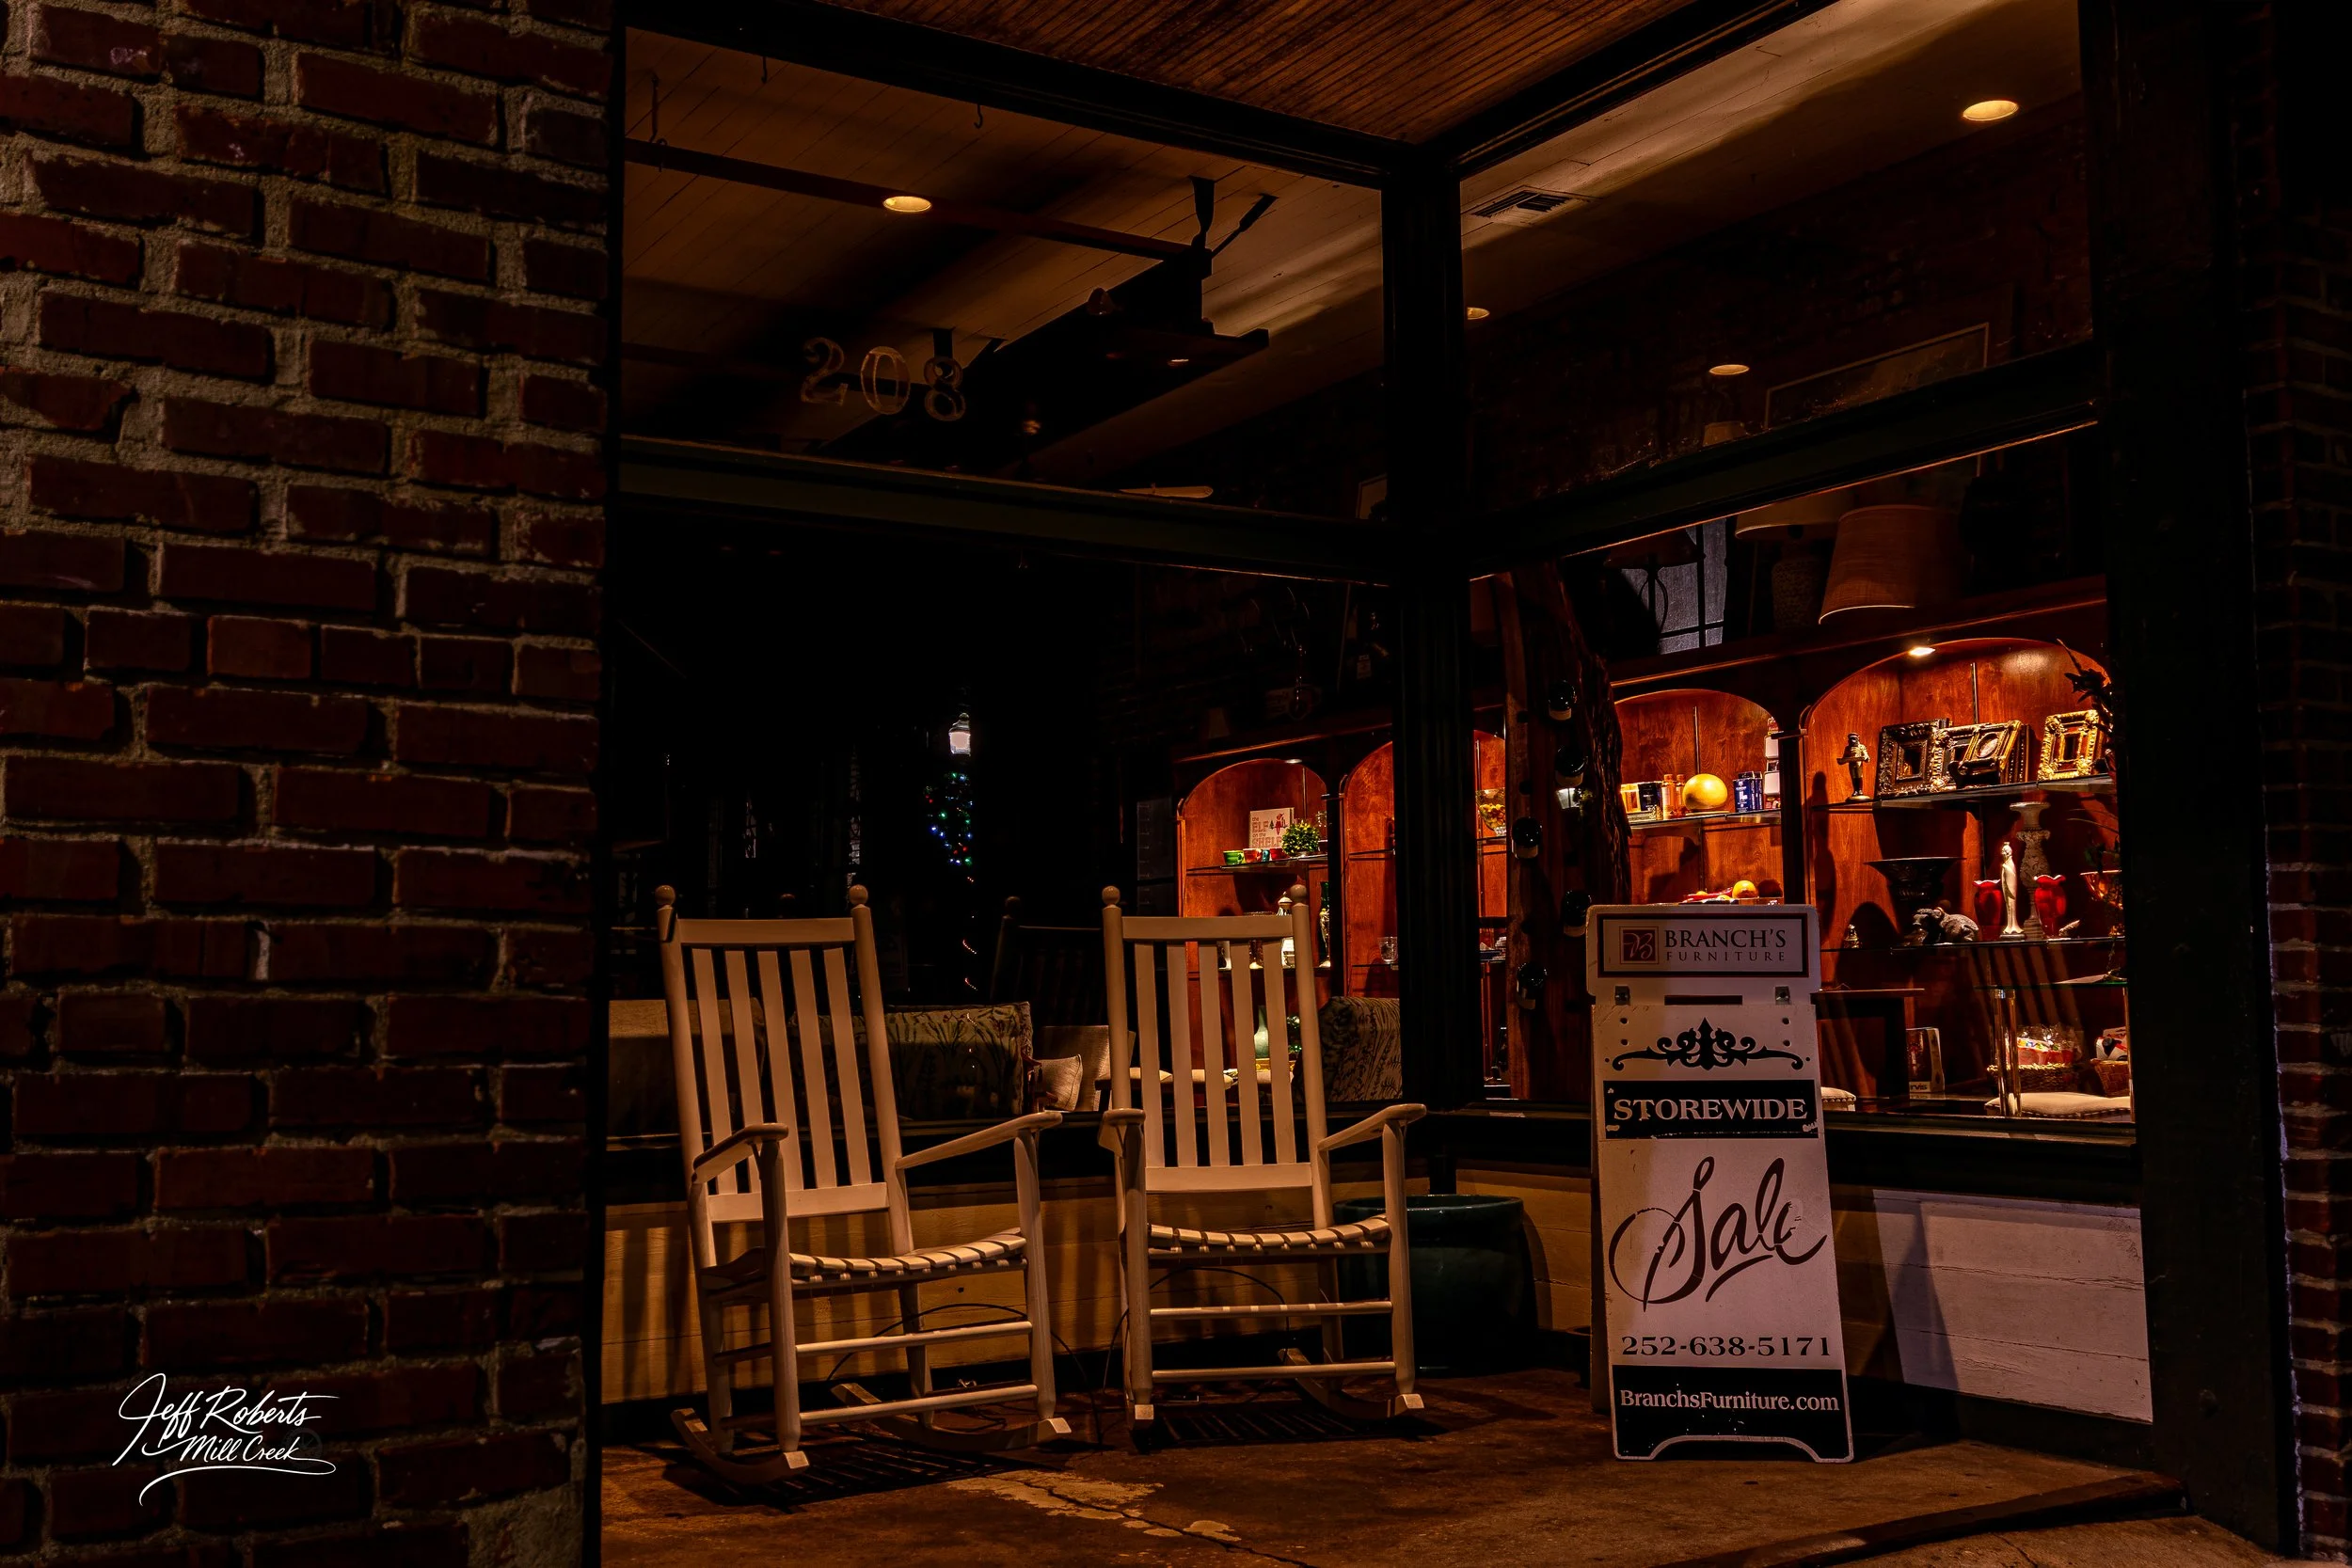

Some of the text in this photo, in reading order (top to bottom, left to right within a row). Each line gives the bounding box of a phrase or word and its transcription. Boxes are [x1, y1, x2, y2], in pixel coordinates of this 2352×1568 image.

[800, 335, 968, 422] 208
[1252, 821, 1268, 832] ELF
[1664, 929, 1786, 948] BRANCH'S
[1666, 951, 1786, 961] FURNITURE
[1613, 1099, 1808, 1121] STOREWIDE
[1609, 1156, 1828, 1312] Sale
[1621, 1336, 1831, 1356] 252-638-5171
[1620, 1389, 1840, 1411] BranchsFurniture.com
